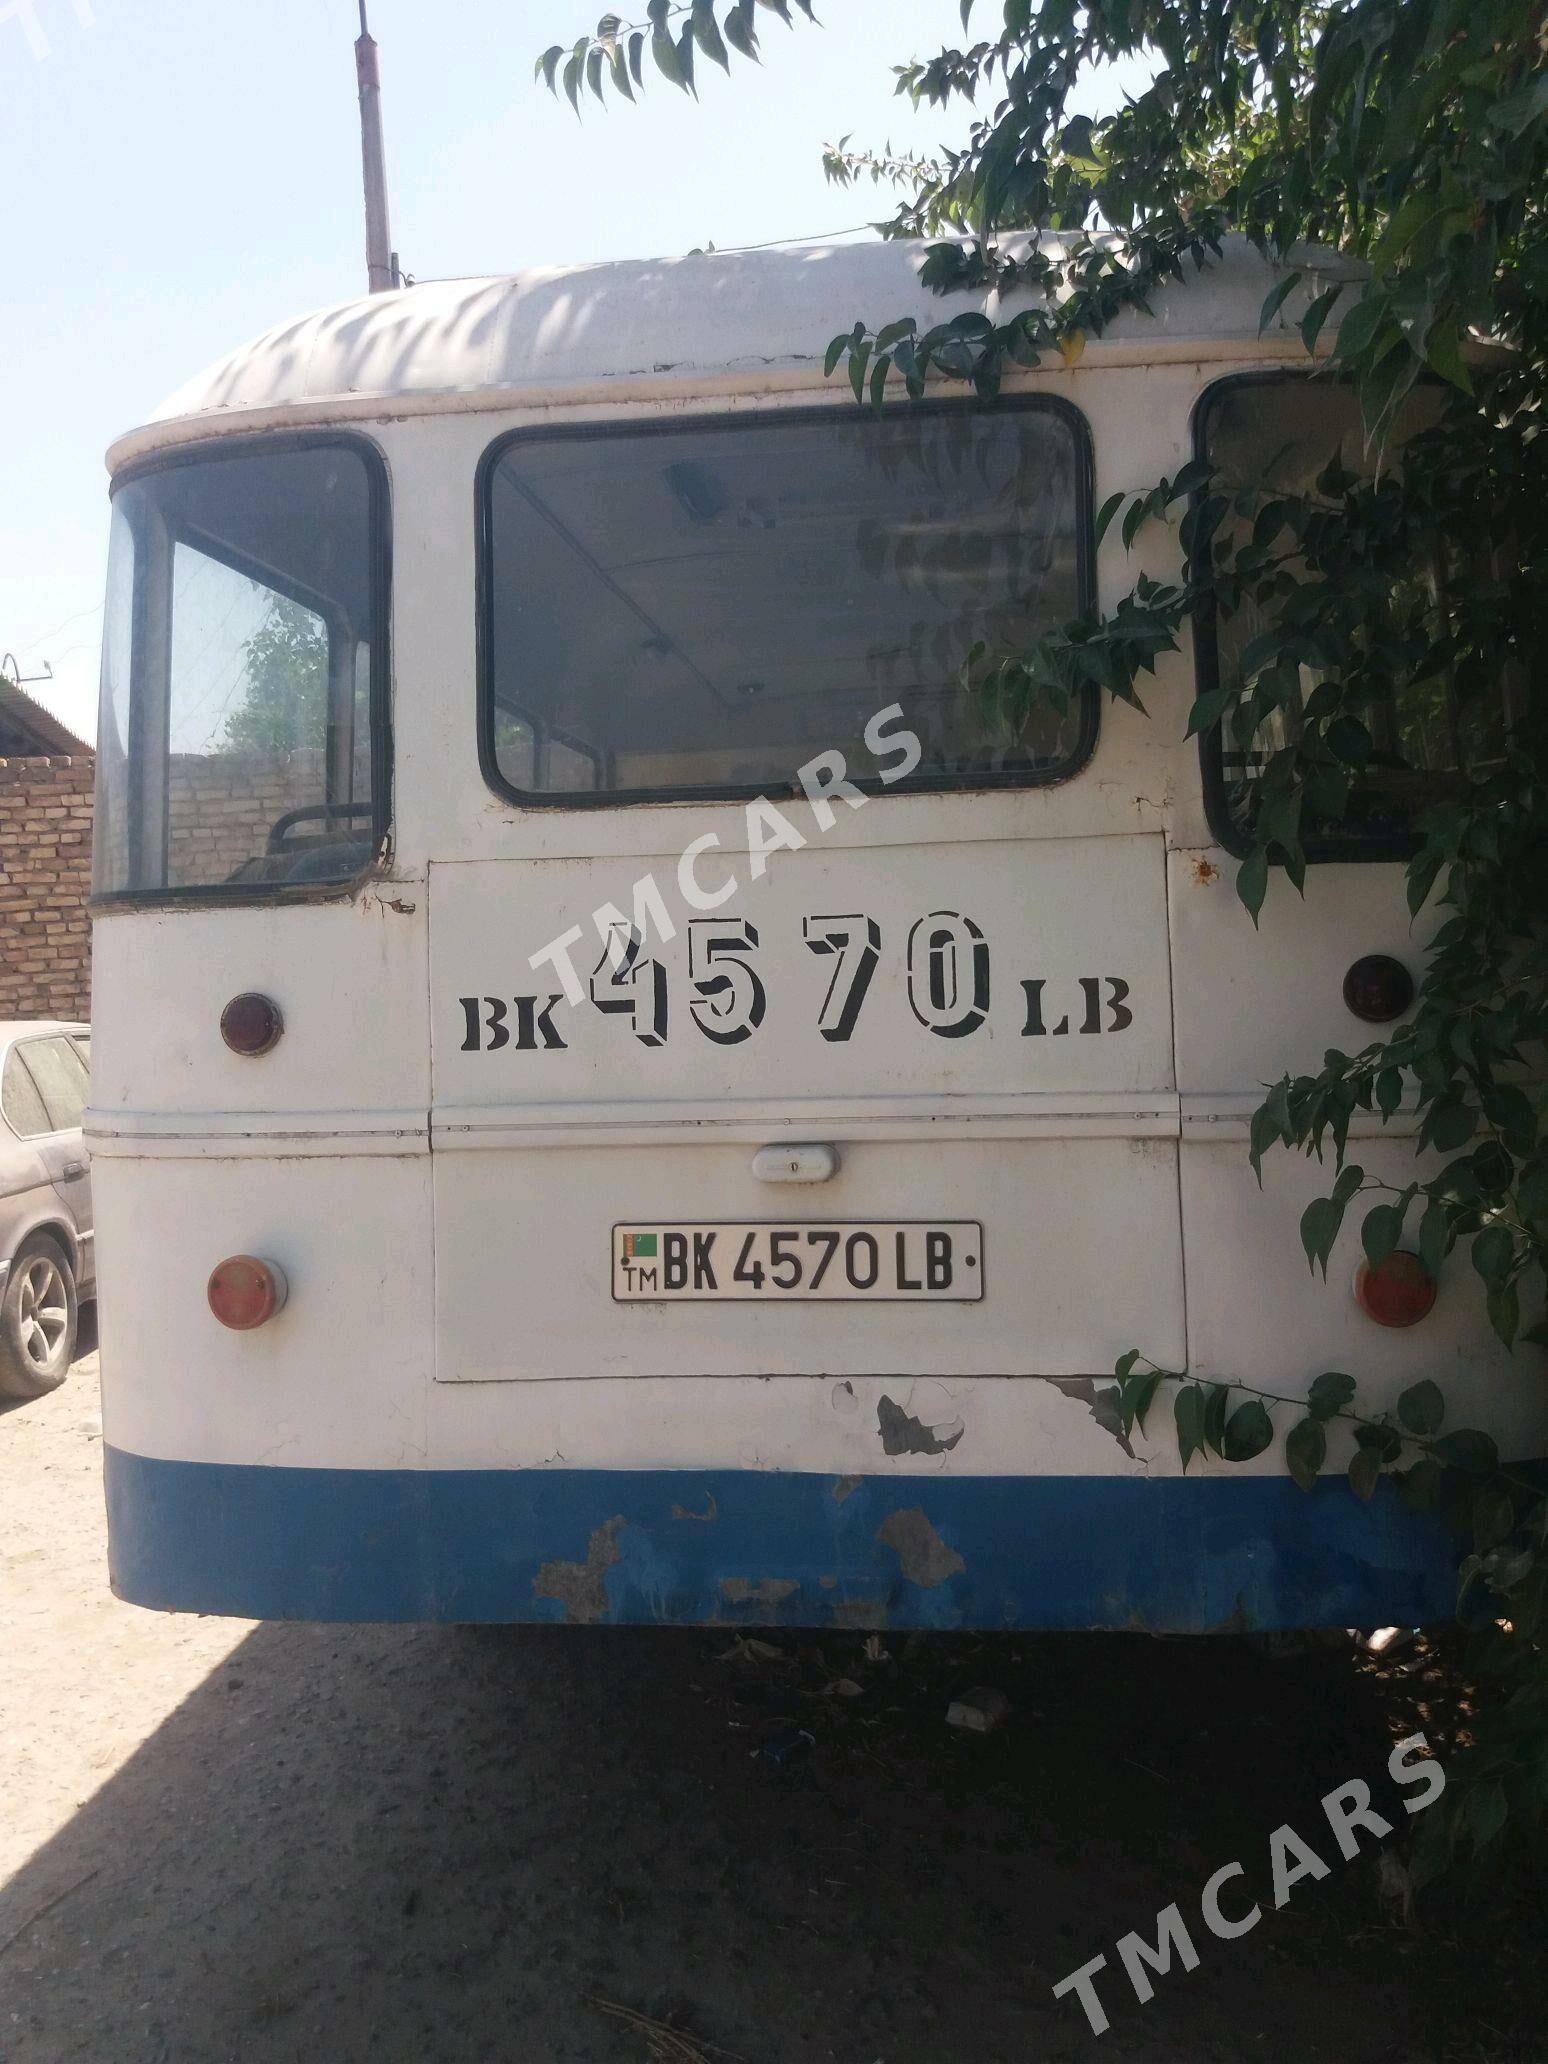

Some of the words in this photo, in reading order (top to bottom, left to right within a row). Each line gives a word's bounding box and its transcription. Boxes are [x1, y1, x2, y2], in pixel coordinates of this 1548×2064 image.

[459, 994, 568, 1051] BK
[590, 911, 990, 1047] 4570
[1021, 977, 1133, 1037] LB
[623, 1267, 657, 1291] TM
[663, 1232, 718, 1289] BK
[733, 1231, 879, 1289] 4570
[896, 1231, 953, 1290] LB
